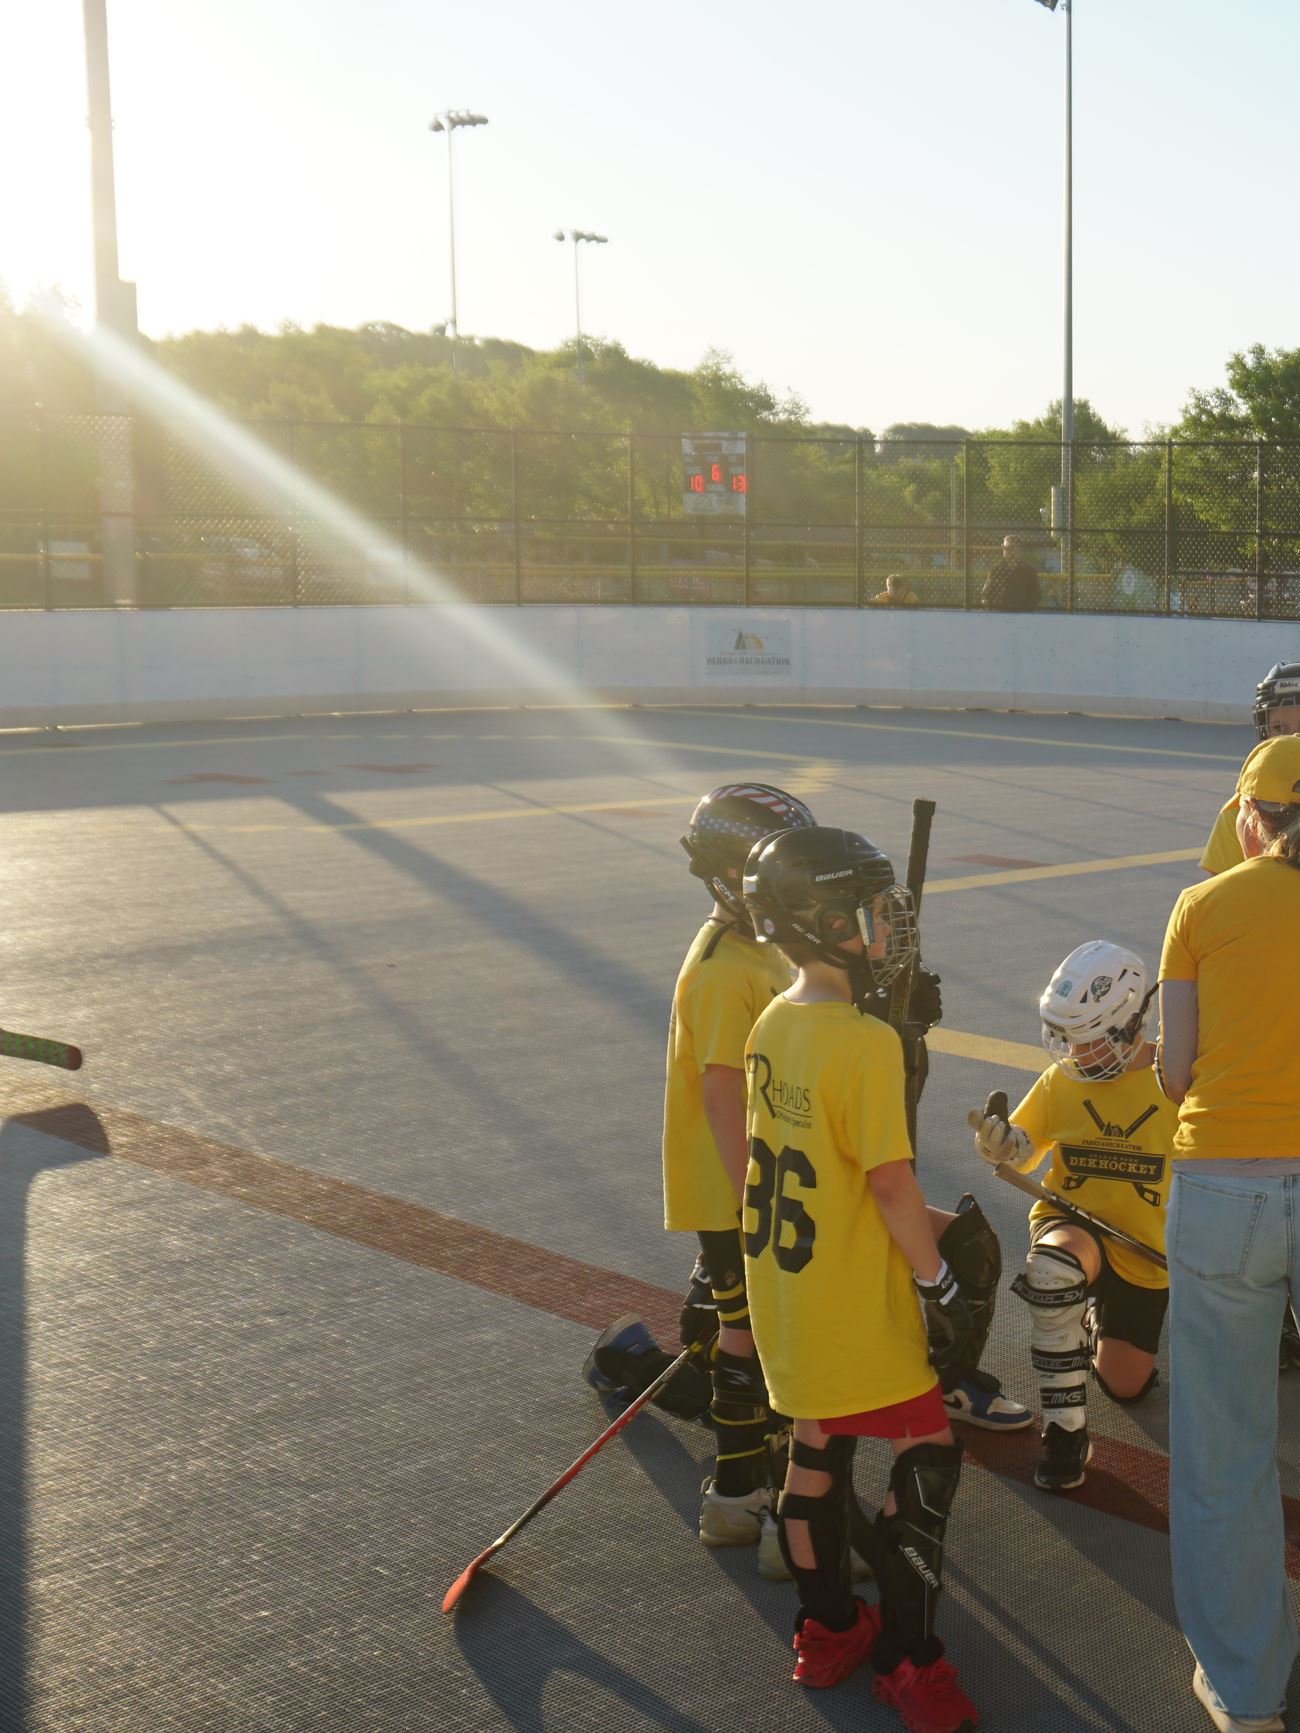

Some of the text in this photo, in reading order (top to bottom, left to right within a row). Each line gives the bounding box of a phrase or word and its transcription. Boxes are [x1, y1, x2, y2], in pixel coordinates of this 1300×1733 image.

[815, 869, 853, 882] BAUER
[712, 876, 736, 902] CCM
[1069, 1156, 1157, 1175] DEKHOCKEY
[744, 1136, 817, 1274] 36
[903, 1546, 939, 1589] BAUER
